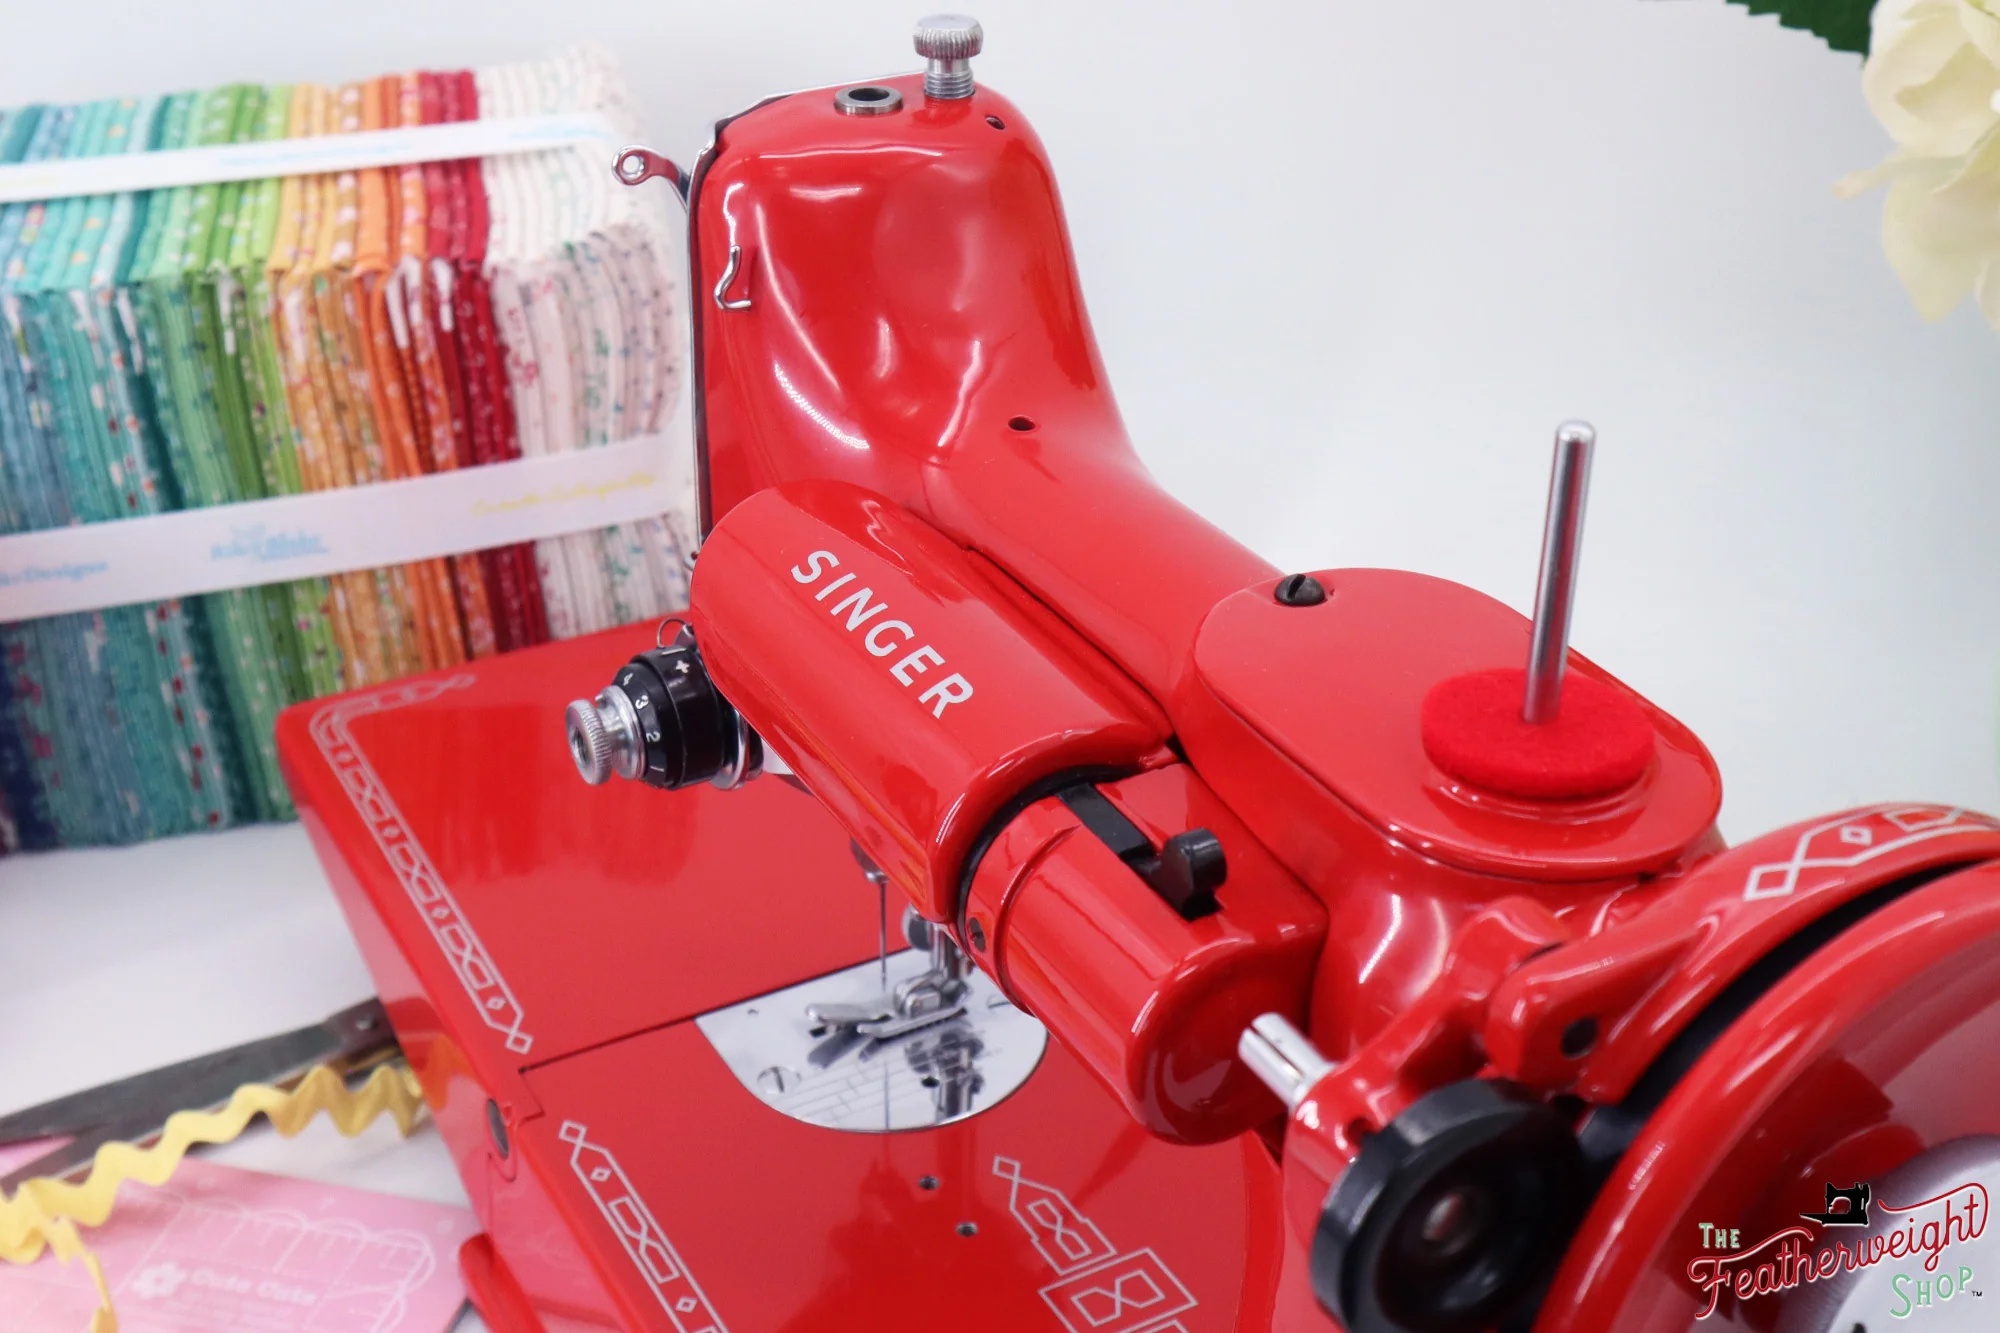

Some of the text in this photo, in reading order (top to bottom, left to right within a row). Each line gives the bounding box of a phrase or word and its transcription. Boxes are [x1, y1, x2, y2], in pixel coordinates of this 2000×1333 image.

[791, 550, 974, 720] SINGER
[635, 695, 649, 710] 3
[646, 731, 661, 743] 2
